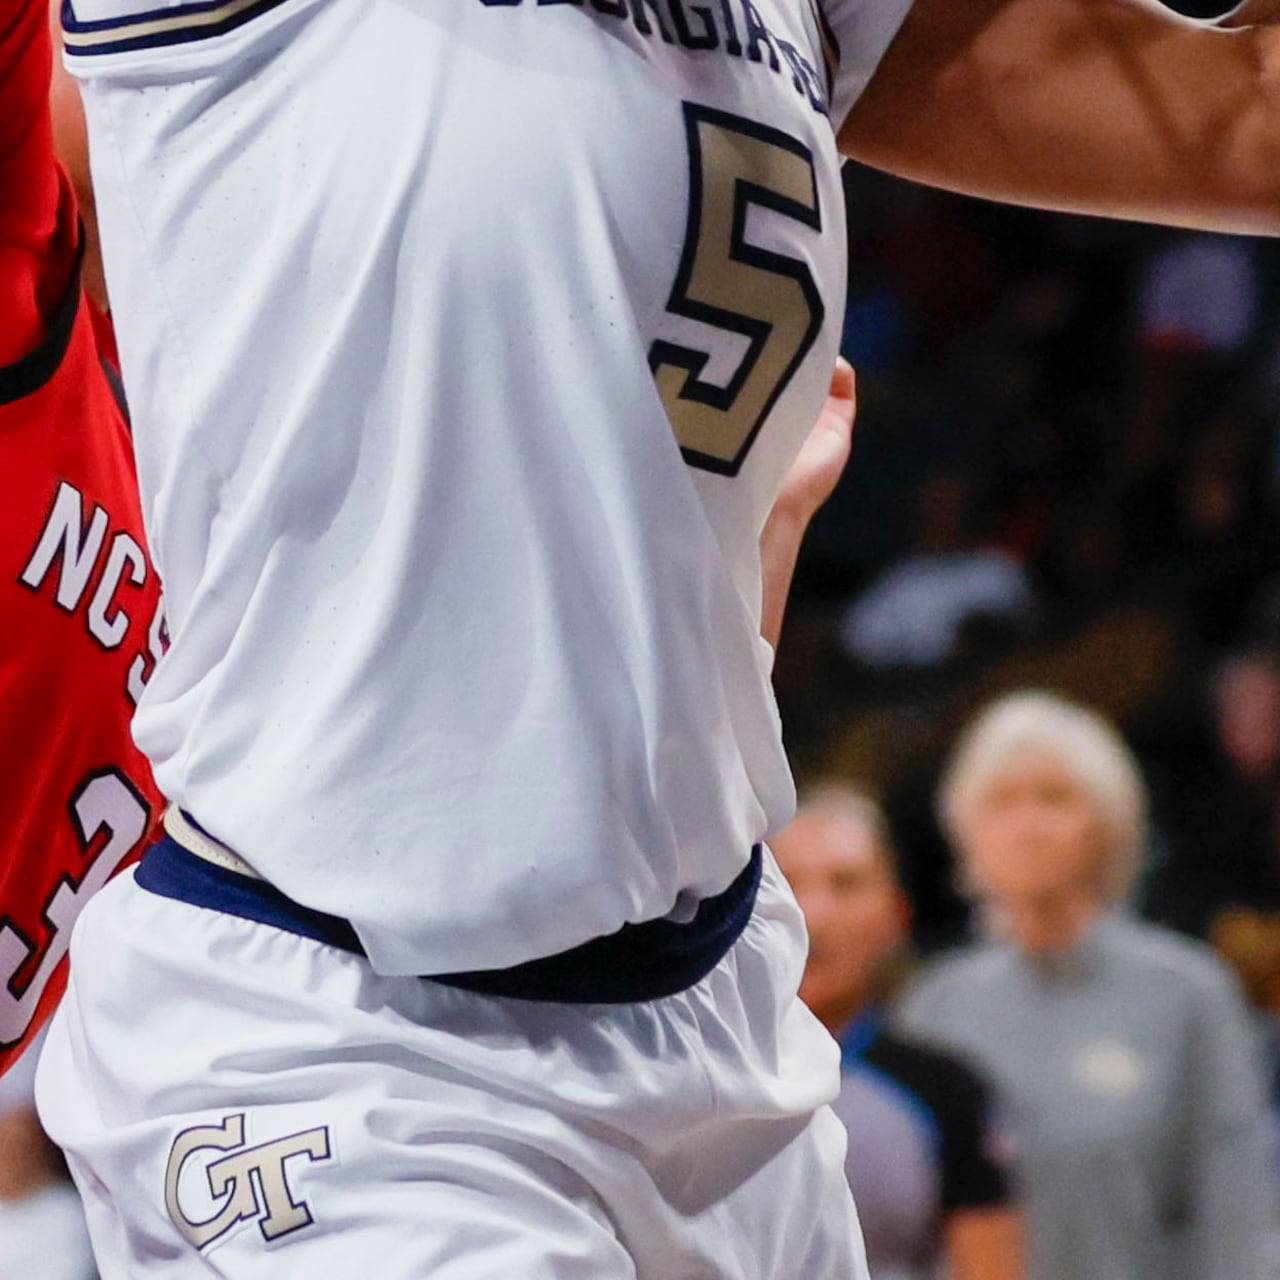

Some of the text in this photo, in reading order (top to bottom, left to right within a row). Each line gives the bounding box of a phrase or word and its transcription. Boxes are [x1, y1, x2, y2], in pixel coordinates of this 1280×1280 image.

[646, 99, 826, 478] 5
[17, 477, 147, 652] NC
[164, 1112, 332, 1252] GT
